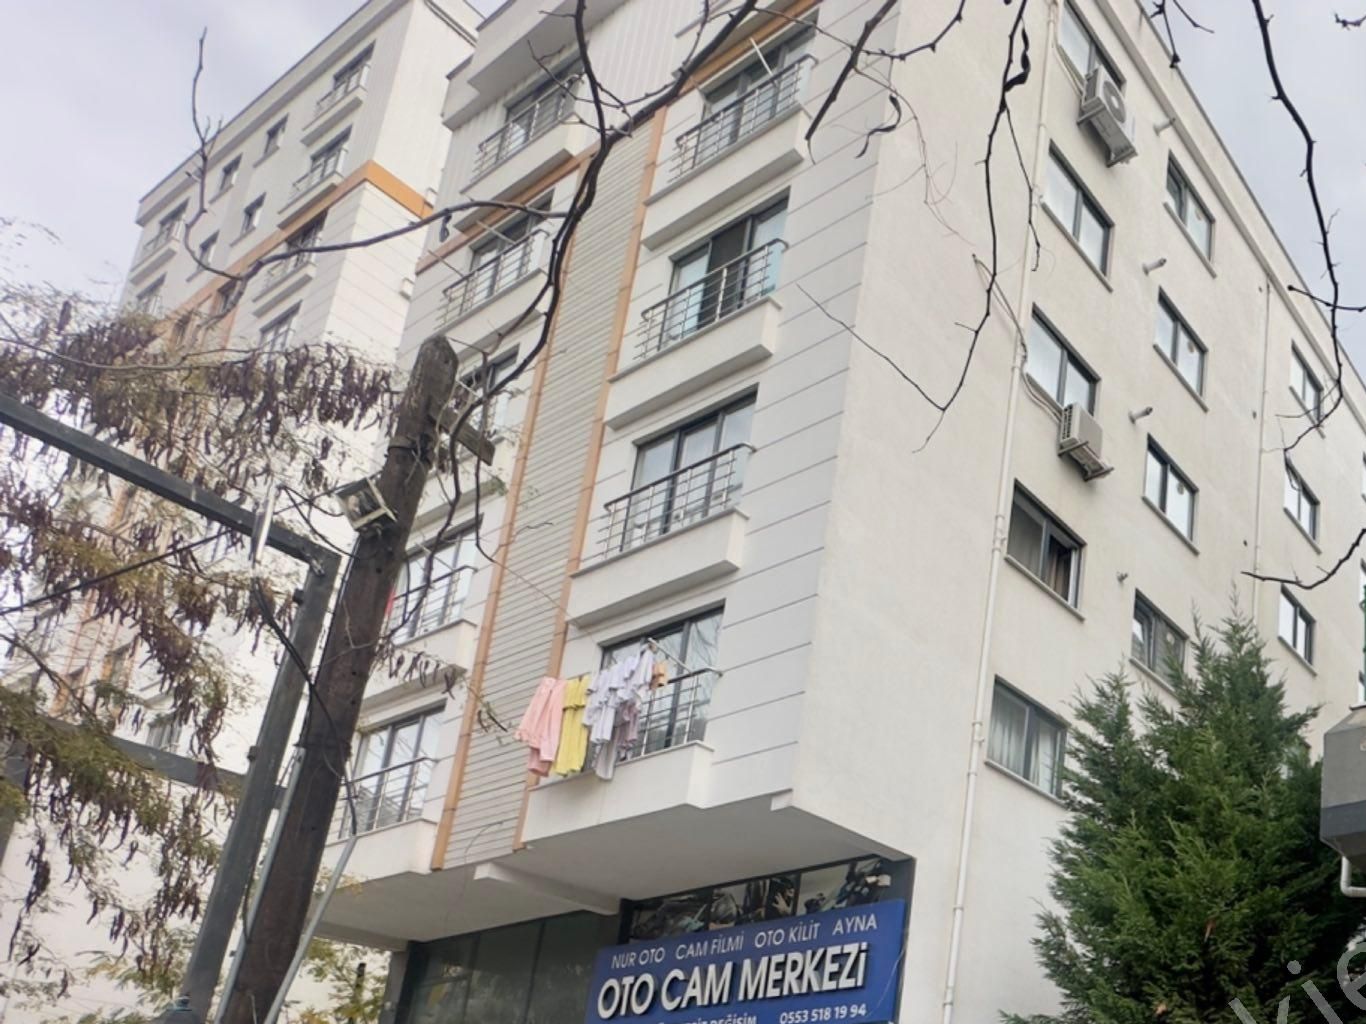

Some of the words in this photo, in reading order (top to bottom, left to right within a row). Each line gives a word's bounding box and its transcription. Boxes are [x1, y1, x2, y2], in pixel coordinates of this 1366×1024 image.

[611, 951, 637, 969] NUR
[638, 946, 666, 966] OTO
[675, 940, 708, 961] CAM
[711, 930, 744, 955] FİLMİ
[754, 928, 785, 949] OTO
[788, 919, 821, 943] KİLİT
[832, 913, 878, 936] AYNA
[597, 972, 655, 1020] OTO
[660, 961, 734, 1012] CAM
[810, 1006, 832, 1022] 518
[834, 1005, 849, 1020] 19
[849, 1003, 868, 1019] 94
